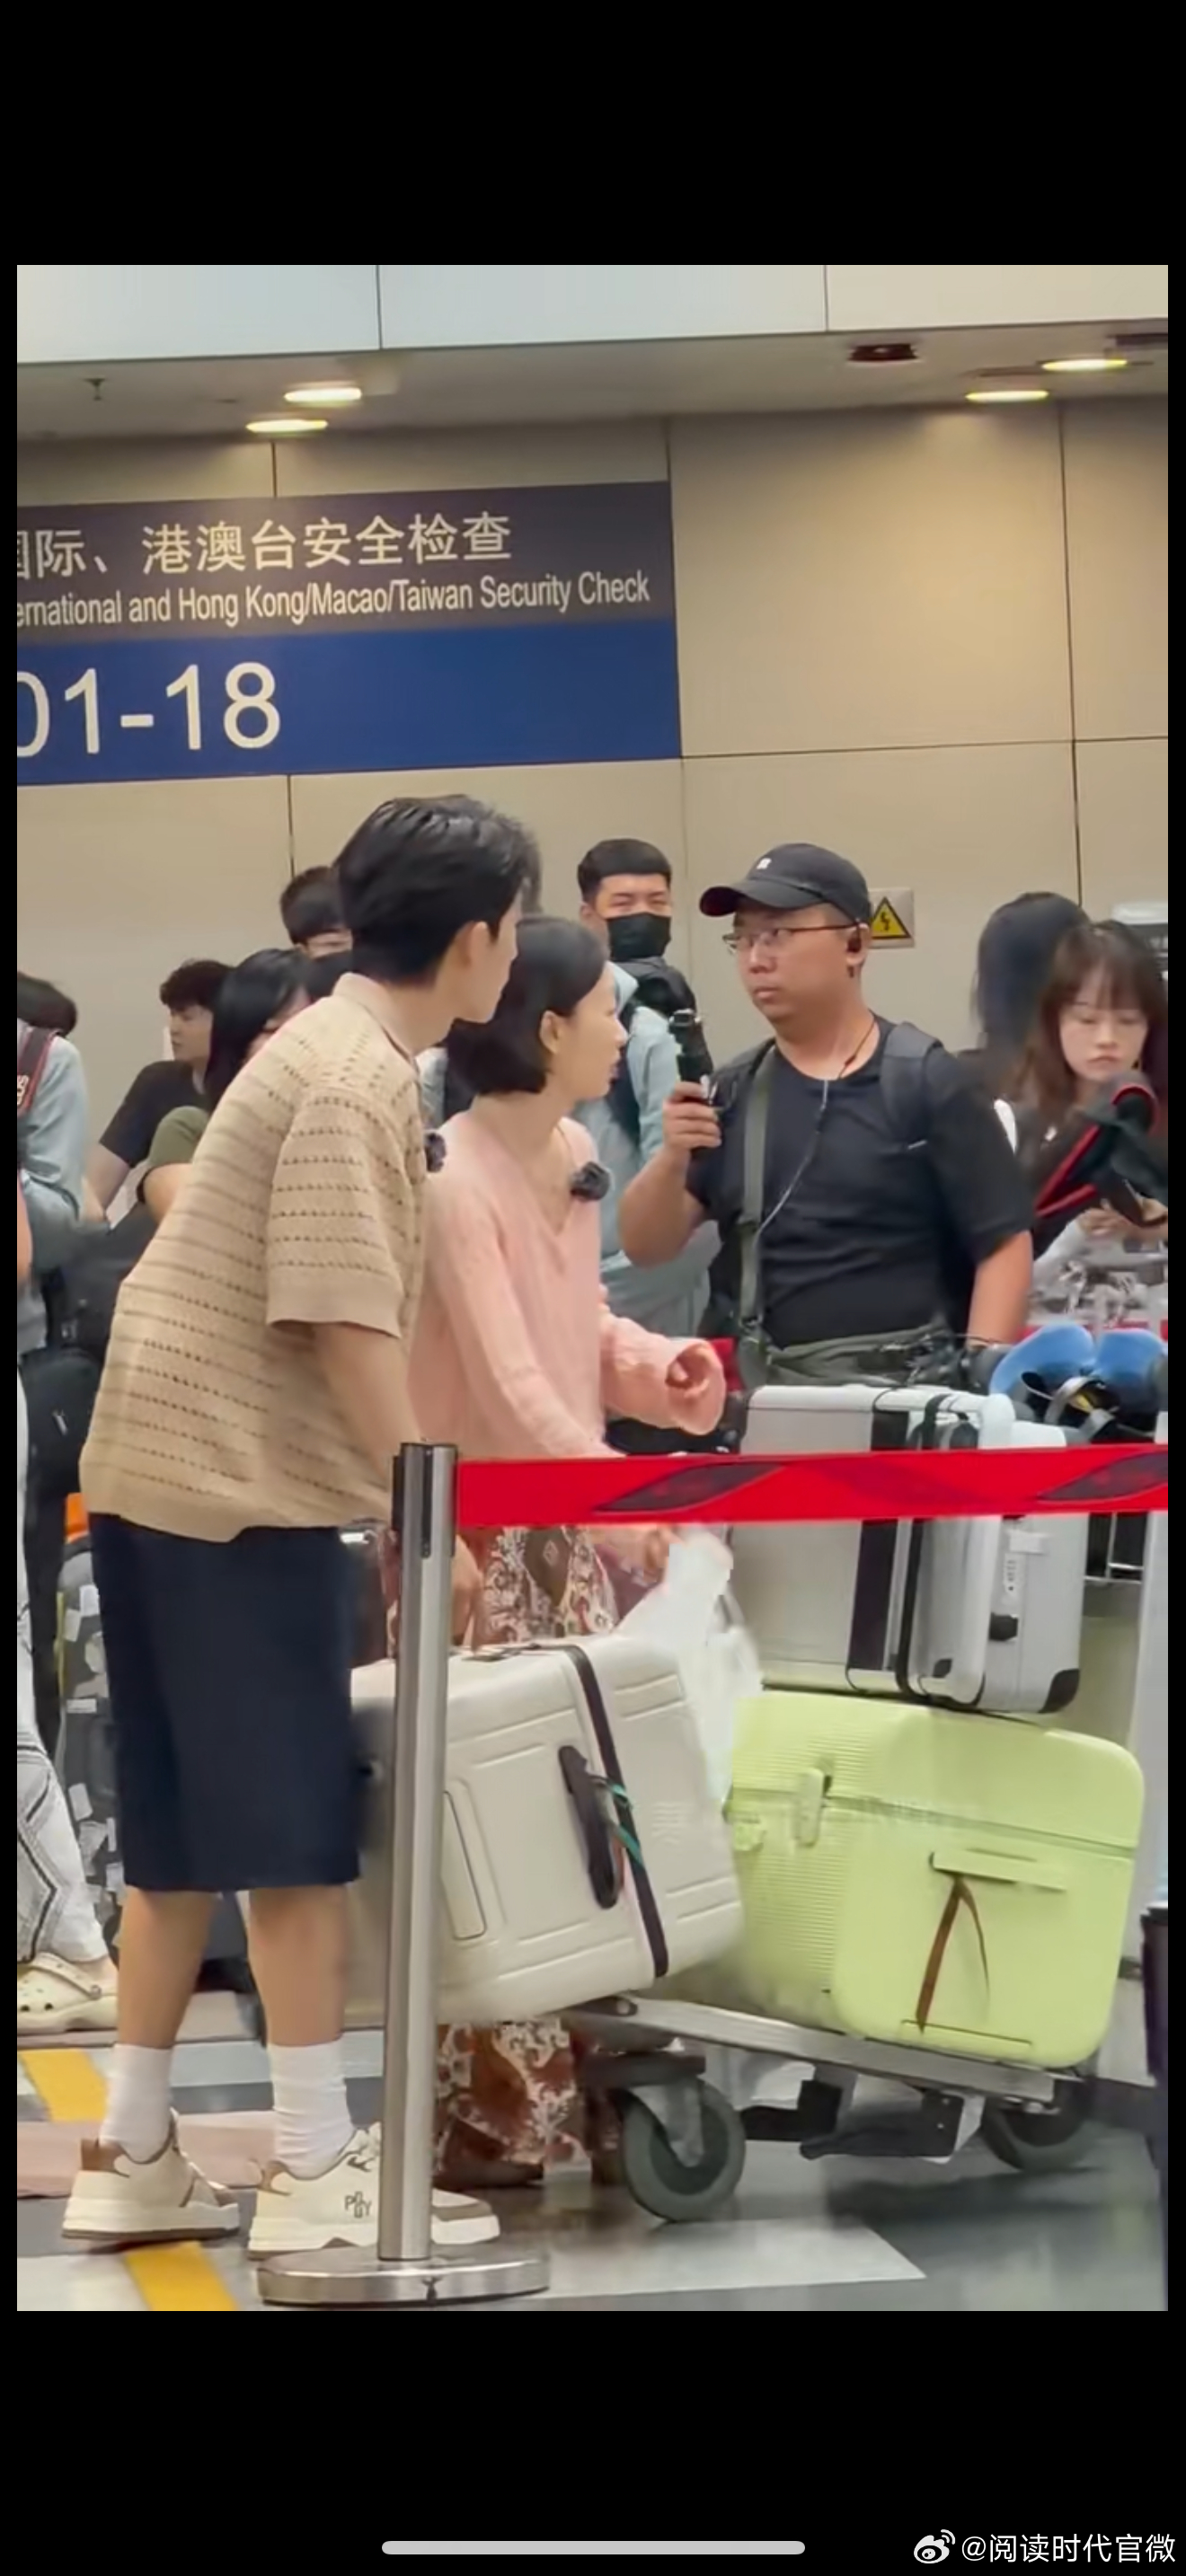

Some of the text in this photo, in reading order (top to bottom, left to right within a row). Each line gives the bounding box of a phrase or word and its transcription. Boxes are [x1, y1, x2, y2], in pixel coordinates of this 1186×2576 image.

[128, 587, 173, 623] and
[179, 584, 240, 627] Hong
[246, 578, 474, 625] Kong/Macao/Taiwan
[480, 573, 571, 614] Security
[578, 569, 651, 605] Check
